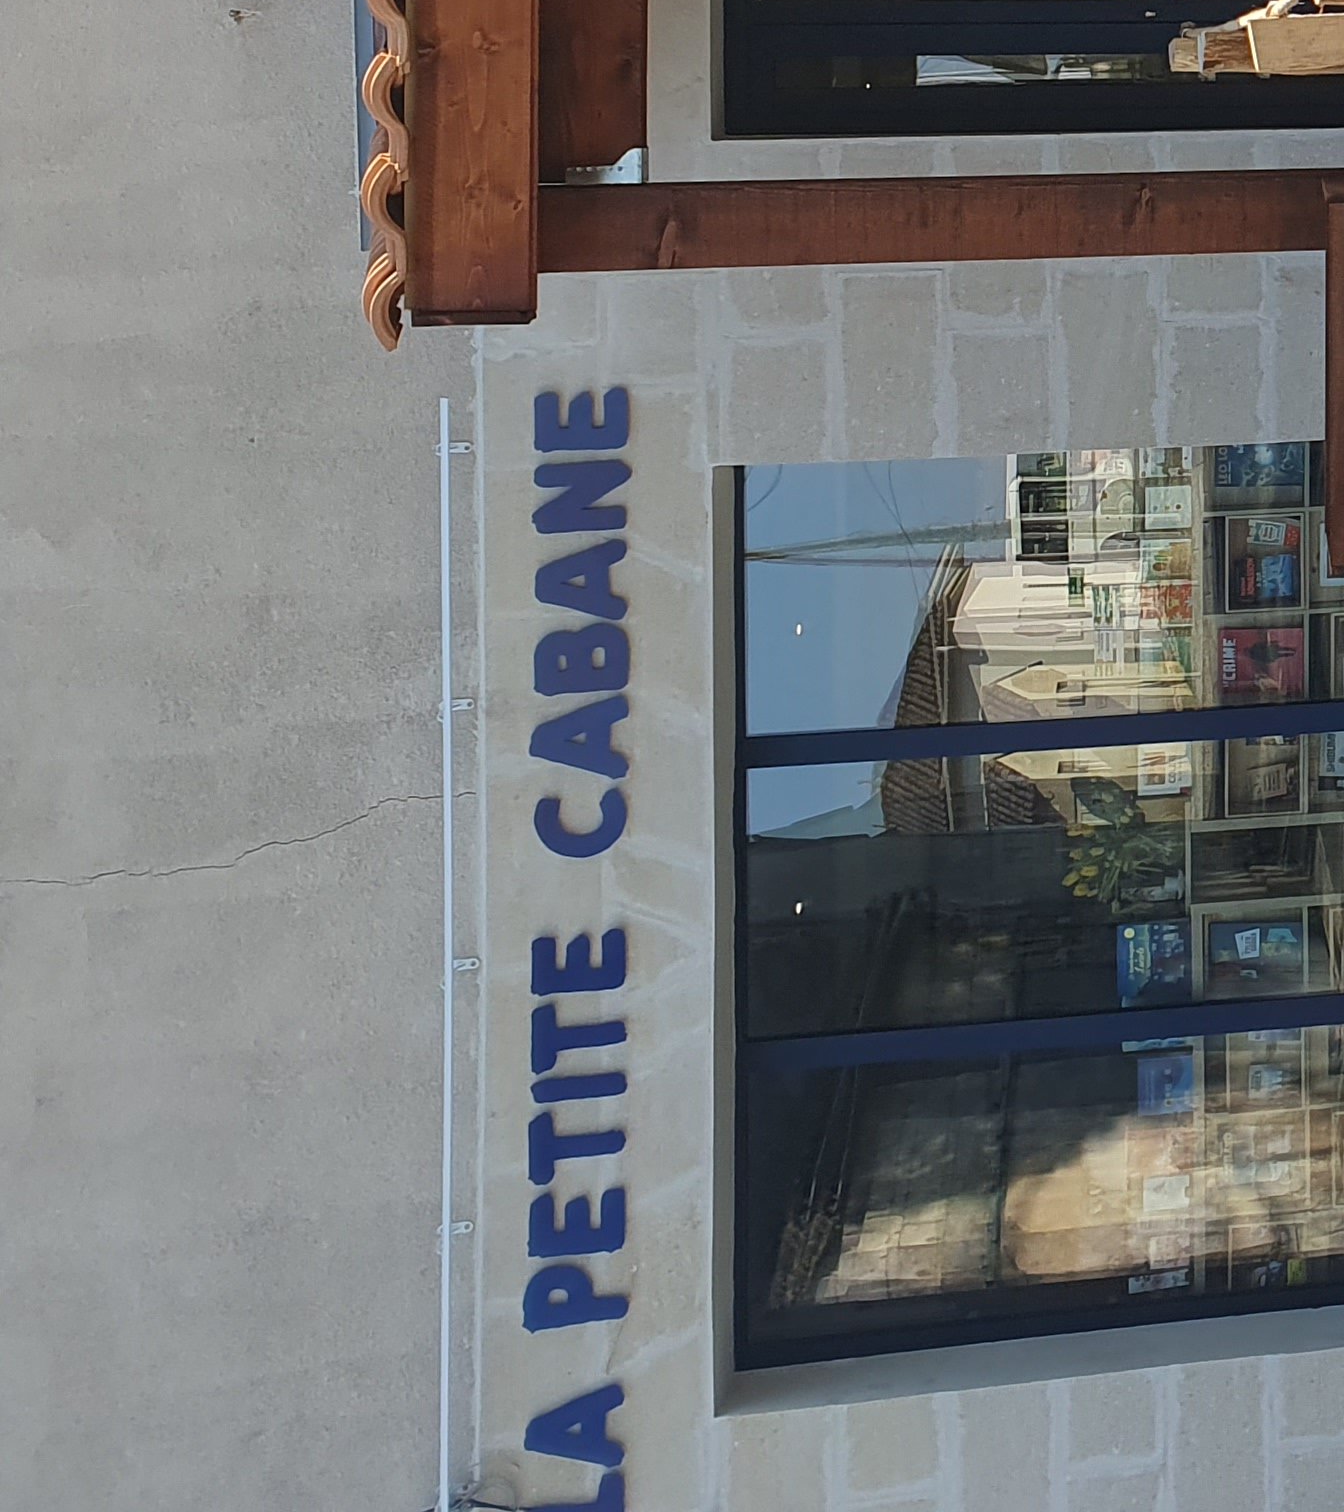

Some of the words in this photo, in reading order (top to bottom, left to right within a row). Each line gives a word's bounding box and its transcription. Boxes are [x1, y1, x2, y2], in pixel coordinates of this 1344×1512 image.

[528, 386, 633, 859] CABANE
[1222, 638, 1237, 681] CRIME
[521, 927, 630, 1334] PETITE
[517, 1383, 626, 1512] LA
